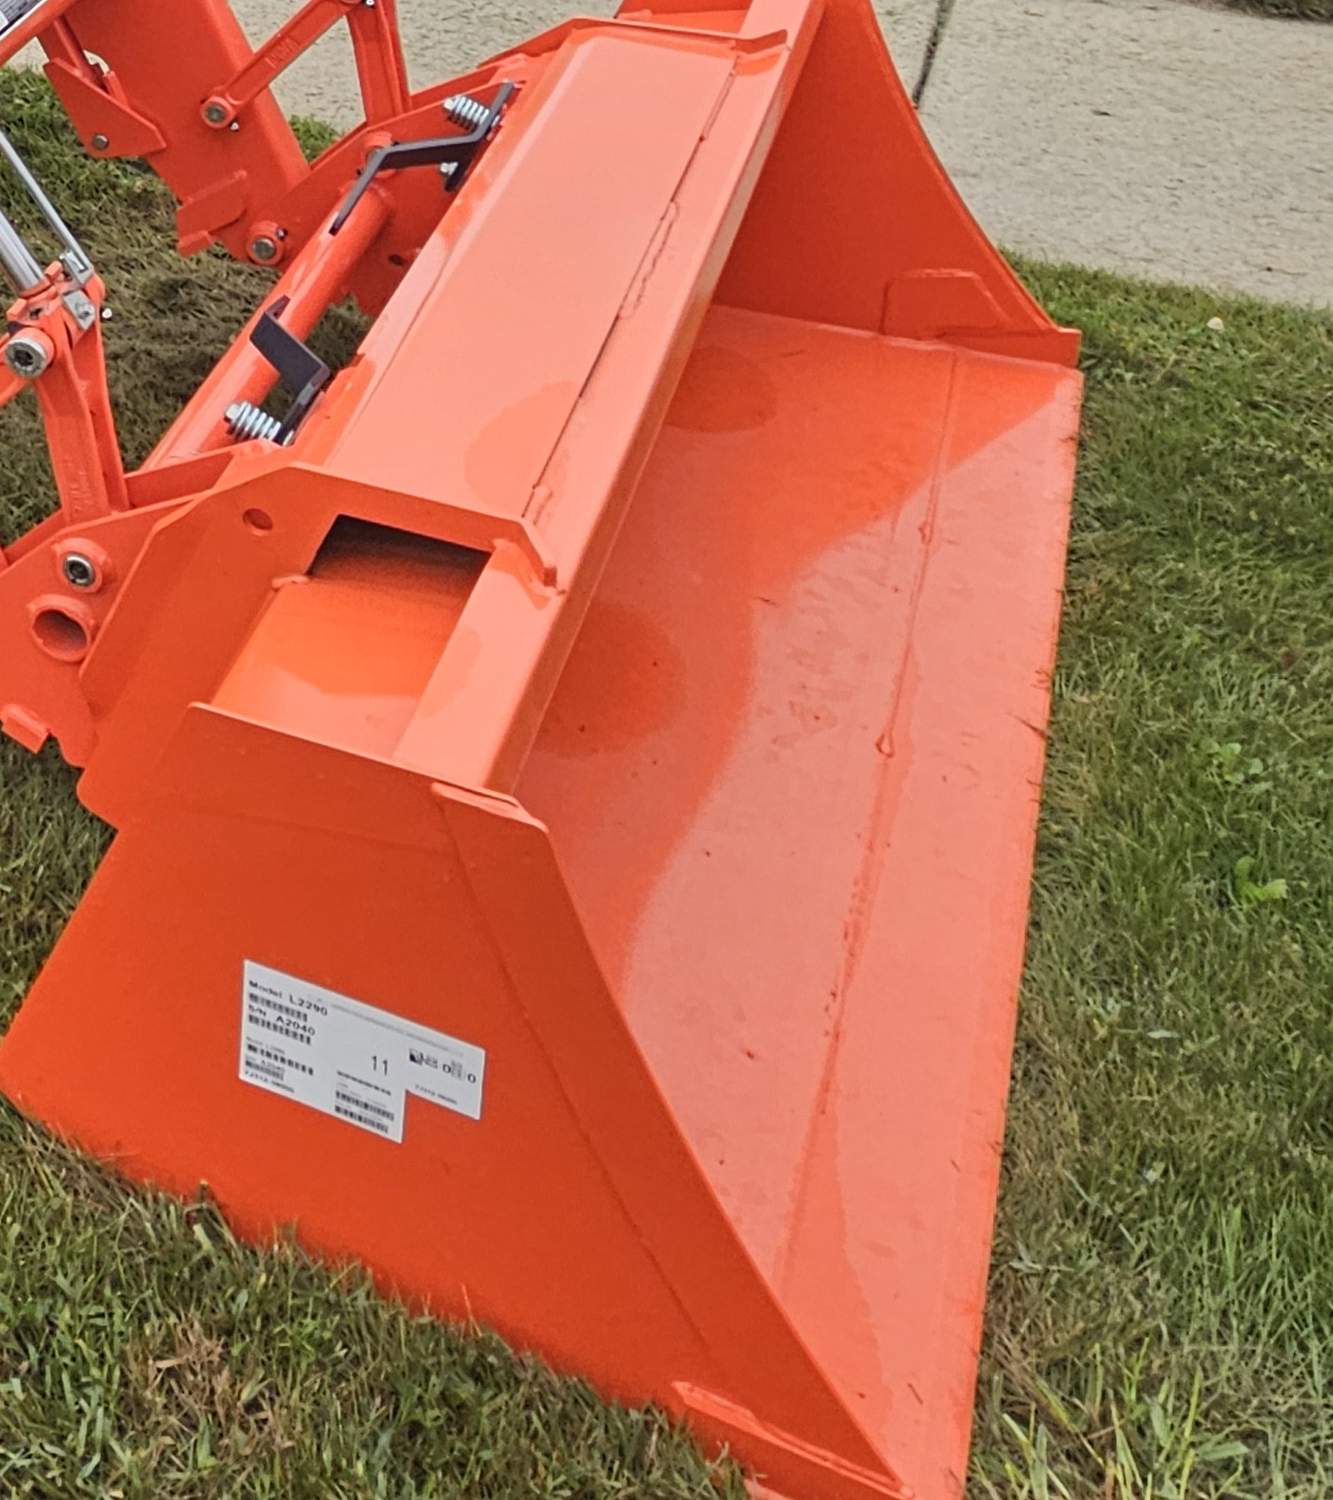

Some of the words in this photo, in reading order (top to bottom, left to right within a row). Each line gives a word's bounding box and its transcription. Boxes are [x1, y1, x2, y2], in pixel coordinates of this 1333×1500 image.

[248, 980, 283, 998] Model
[289, 994, 328, 1016] L2290
[276, 1015, 316, 1036] A2040
[370, 1055, 389, 1077] 11
